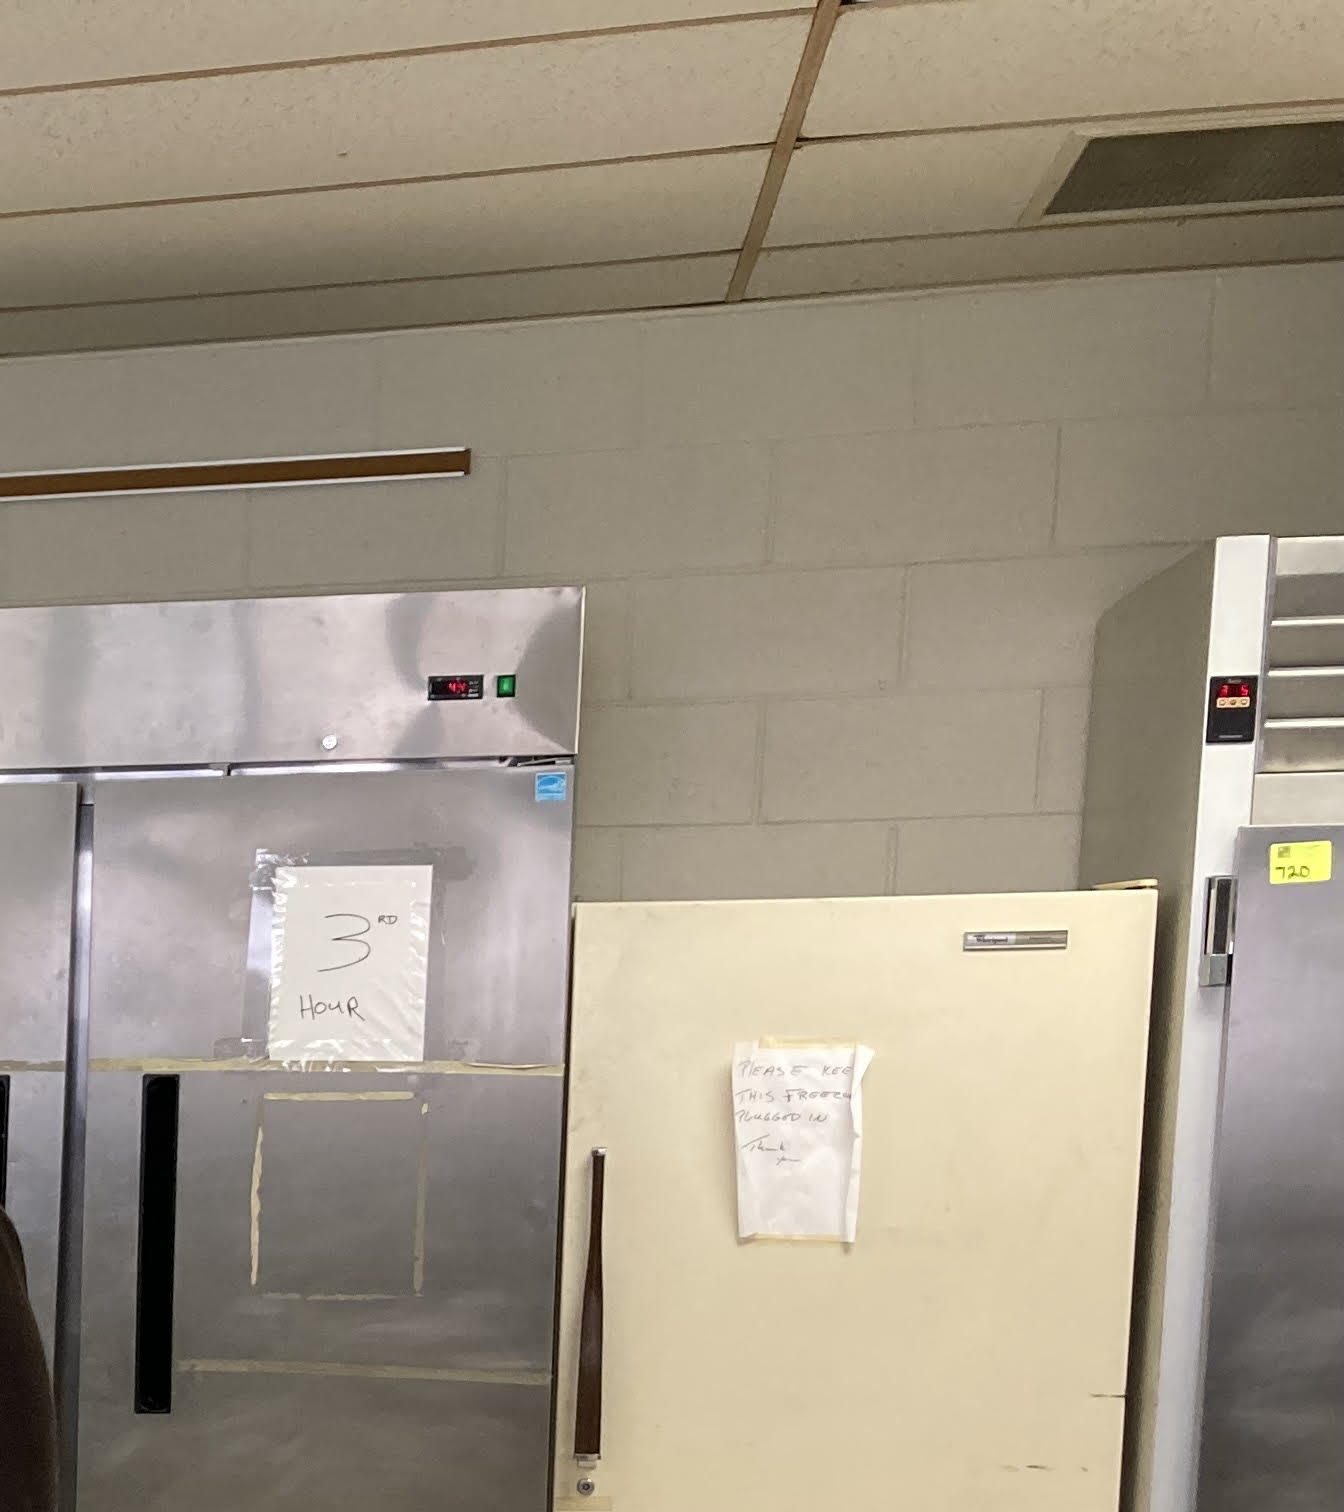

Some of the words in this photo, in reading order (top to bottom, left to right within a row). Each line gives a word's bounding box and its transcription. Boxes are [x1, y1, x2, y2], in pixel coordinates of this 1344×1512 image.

[1275, 865, 1310, 879] 720
[299, 994, 366, 1021] HOUR
[822, 1065, 853, 1076] KEE
